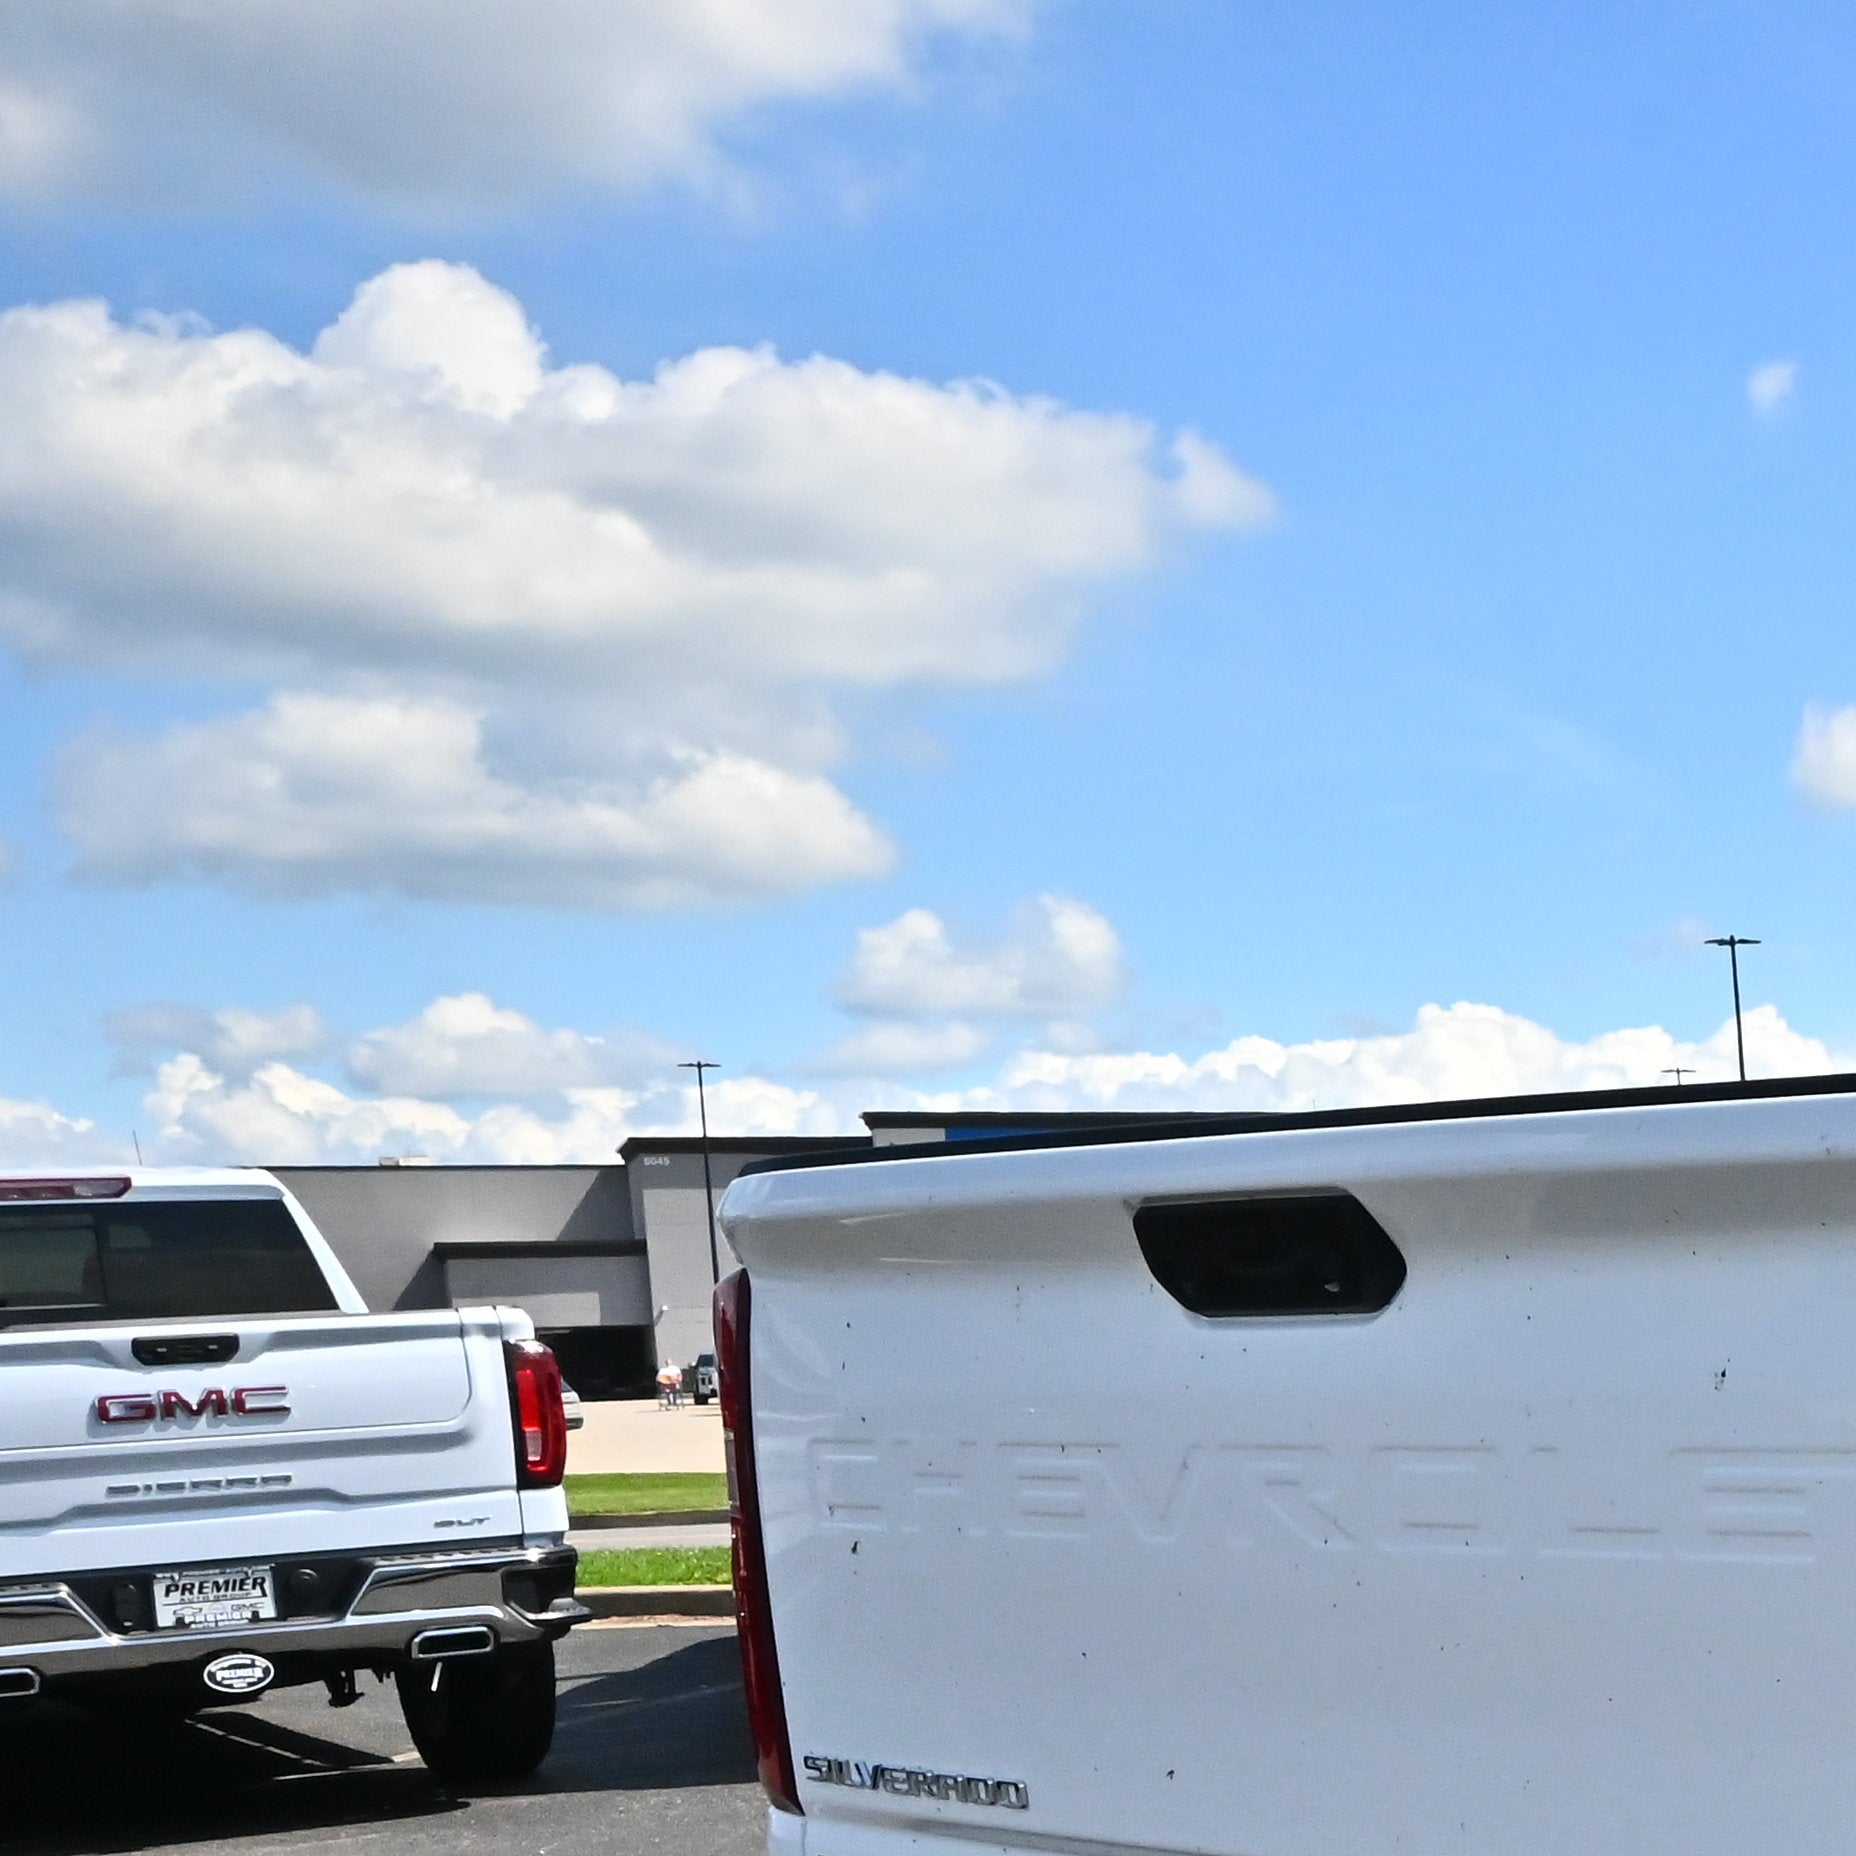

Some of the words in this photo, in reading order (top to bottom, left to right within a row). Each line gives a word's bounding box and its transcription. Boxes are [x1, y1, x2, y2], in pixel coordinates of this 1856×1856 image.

[95, 1385, 292, 1424] GMC
[164, 1576, 268, 1598] PREMIER
[803, 1755, 1030, 1810] SILVERADO
